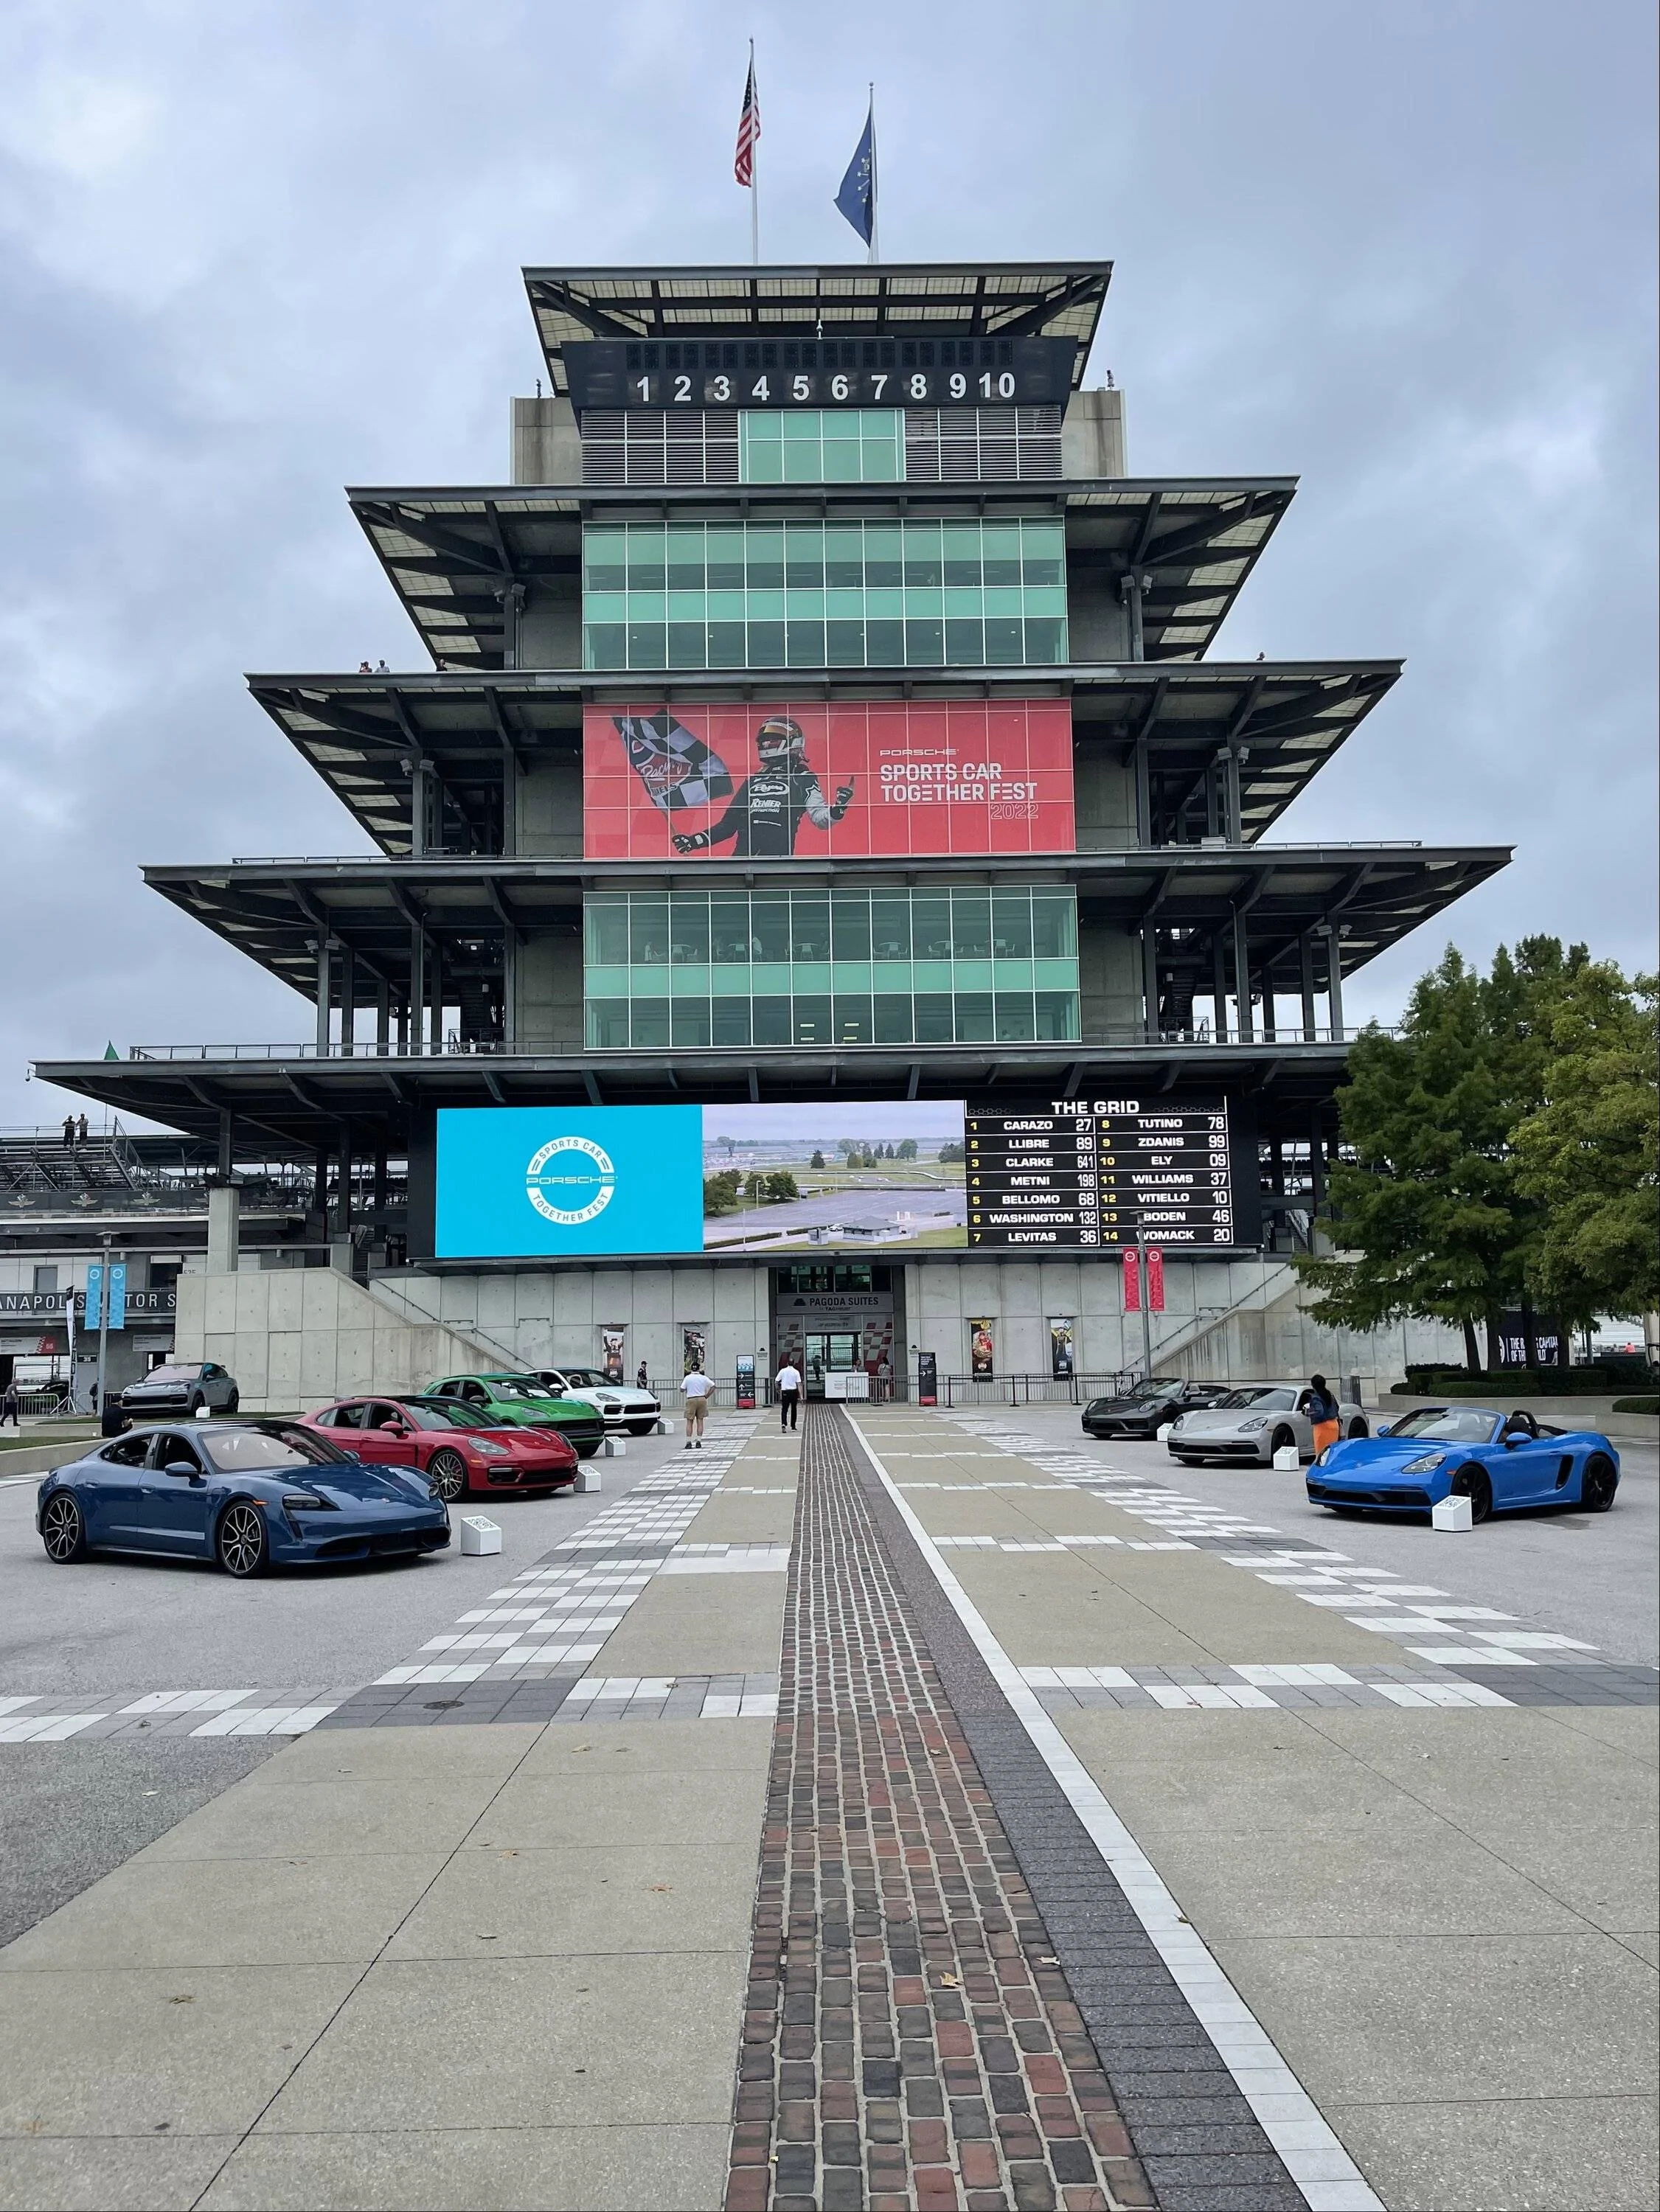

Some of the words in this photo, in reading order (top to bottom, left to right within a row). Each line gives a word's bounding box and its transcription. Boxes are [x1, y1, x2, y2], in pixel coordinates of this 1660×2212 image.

[636, 376, 650, 402] 1
[674, 375, 691, 401] 2
[714, 375, 731, 401] 3
[751, 375, 770, 400] 4
[793, 375, 809, 400] 5
[832, 375, 848, 400] 6
[871, 375, 888, 400] 7
[910, 374, 927, 399] 8
[950, 373, 966, 399] 9
[979, 372, 1015, 398] 10
[881, 764, 957, 782] SPORTS
[962, 763, 1001, 780] CAR
[881, 783, 984, 801] TOGETHER
[990, 782, 1038, 800] FEST
[990, 803, 1038, 819] 2022
[1052, 1102, 1088, 1114] THE
[1094, 1100, 1139, 1114] GRID
[970, 1122, 977, 1130] 1
[1004, 1121, 1053, 1130] CARAZO
[1076, 1119, 1091, 1131] 27
[1102, 1120, 1110, 1128] 8
[1138, 1119, 1183, 1128] TUTINO
[1208, 1116, 1224, 1130] 78
[970, 1141, 979, 1149] 2
[1009, 1139, 1049, 1149] LLIBRE
[1076, 1137, 1093, 1150] 89
[1102, 1138, 1111, 1147] 9
[1138, 1137, 1184, 1147] ZDANIS
[1209, 1135, 1225, 1148] 99
[539, 1139, 579, 1159] SPORTS
[583, 1142, 602, 1158] CAR
[971, 1159, 979, 1167] 3
[1006, 1158, 1054, 1167] CLARKE
[1077, 1155, 1094, 1168] 641
[1100, 1157, 1115, 1166] 10
[1151, 1156, 1173, 1166] ELY
[1209, 1153, 1226, 1166] 09
[527, 1175, 615, 1185] PORSCHE
[971, 1178, 980, 1186] 4
[1011, 1176, 1050, 1186] METNI
[1077, 1174, 1094, 1187] 198
[1100, 1175, 1115, 1184] 11
[1131, 1175, 1194, 1184] WILLIAMS
[1210, 1172, 1226, 1186] 37
[973, 1196, 981, 1205] 5
[1002, 1194, 1060, 1204] BELLOMO
[1078, 1193, 1095, 1206] 68
[1101, 1194, 1116, 1203] 12
[1137, 1193, 1190, 1203] VITIELLO
[1212, 1191, 1227, 1204] 10
[533, 1194, 584, 1222] TOGETHER
[587, 1192, 608, 1216] FEST
[973, 1215, 981, 1223] 6
[990, 1213, 1074, 1223] WASHINGTON
[1079, 1211, 1097, 1225] 132
[1102, 1213, 1117, 1222] 13
[1144, 1211, 1186, 1221] BODEN
[1212, 1209, 1229, 1222] 46
[973, 1234, 981, 1242] 7
[1008, 1232, 1057, 1242] LEVITAS
[1080, 1230, 1097, 1243] 36
[1103, 1231, 1119, 1240] 14
[1213, 1228, 1230, 1242] 20
[0, 1293, 85, 1310] NAPOLS
[810, 1297, 847, 1306] PAGODA
[848, 1296, 879, 1306] SUITES
[1510, 1338, 1520, 1349] THE
[1518, 1349, 1527, 1362] TH
